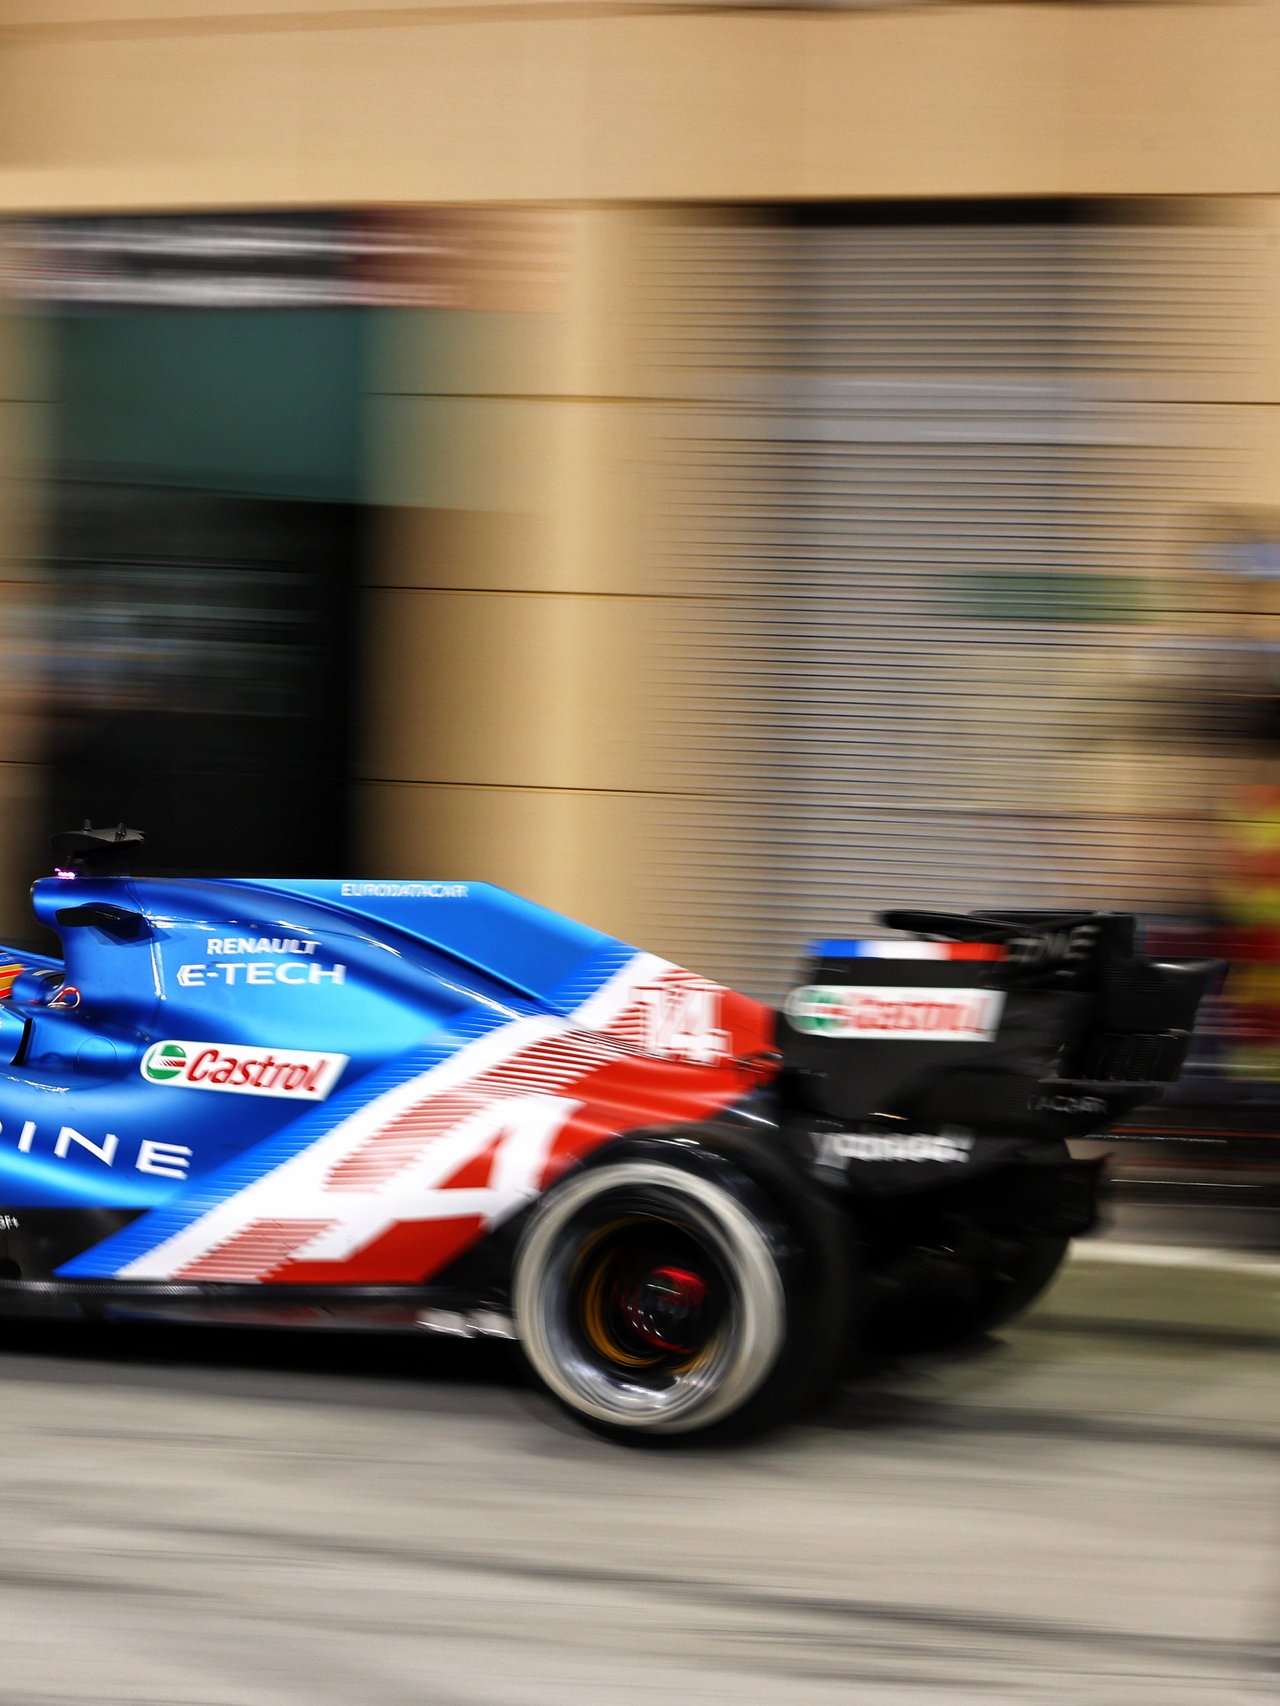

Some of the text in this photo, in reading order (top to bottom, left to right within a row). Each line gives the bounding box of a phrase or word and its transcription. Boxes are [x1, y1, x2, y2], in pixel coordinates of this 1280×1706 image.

[207, 937, 322, 955] RENAULT
[177, 961, 347, 987] E-TECH
[187, 1048, 329, 1092] Castrol
